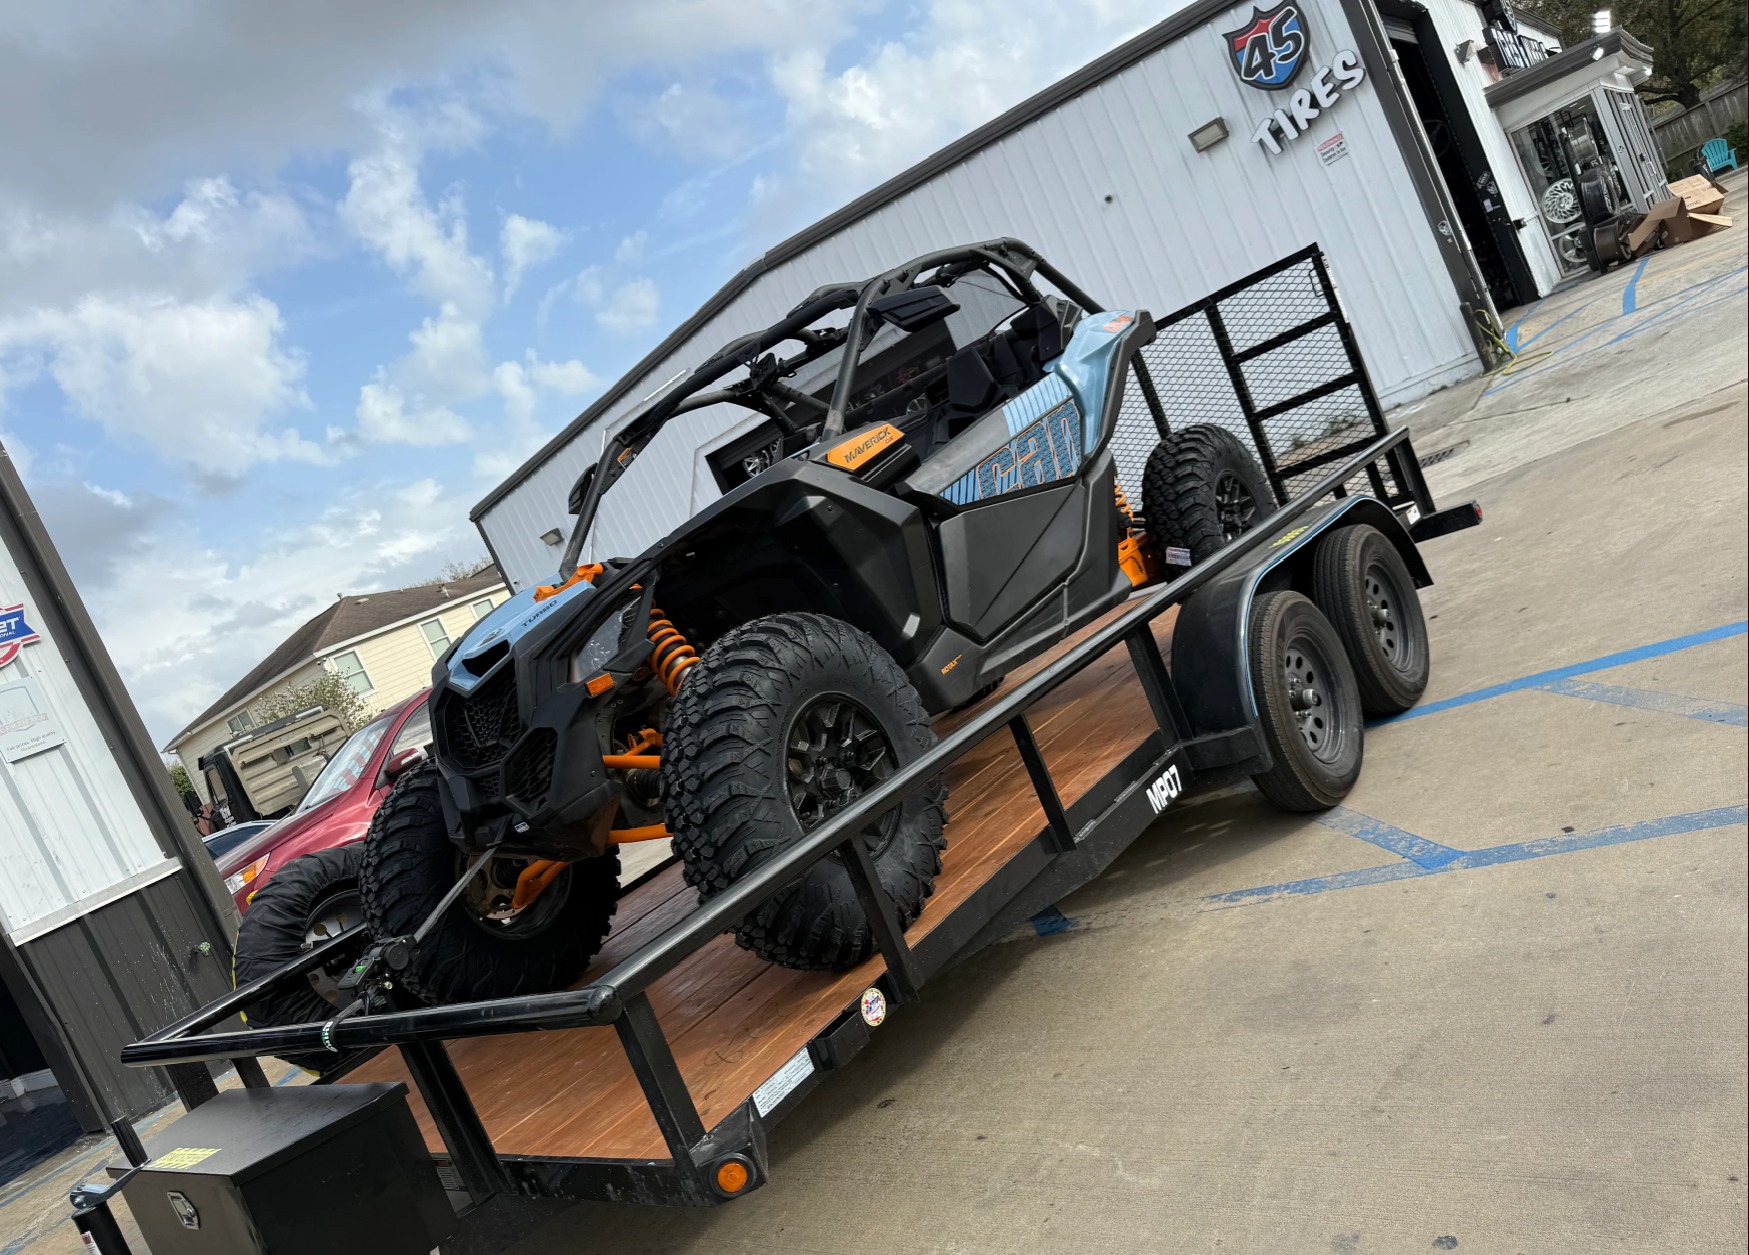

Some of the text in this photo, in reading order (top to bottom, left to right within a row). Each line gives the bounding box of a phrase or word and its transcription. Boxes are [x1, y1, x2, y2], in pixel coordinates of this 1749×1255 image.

[1242, 6, 1304, 80] 45
[1251, 49, 1366, 155] TIRES
[844, 426, 891, 463] MAVERICK
[521, 600, 557, 627] TURBO
[1145, 764, 1182, 814] MP07
